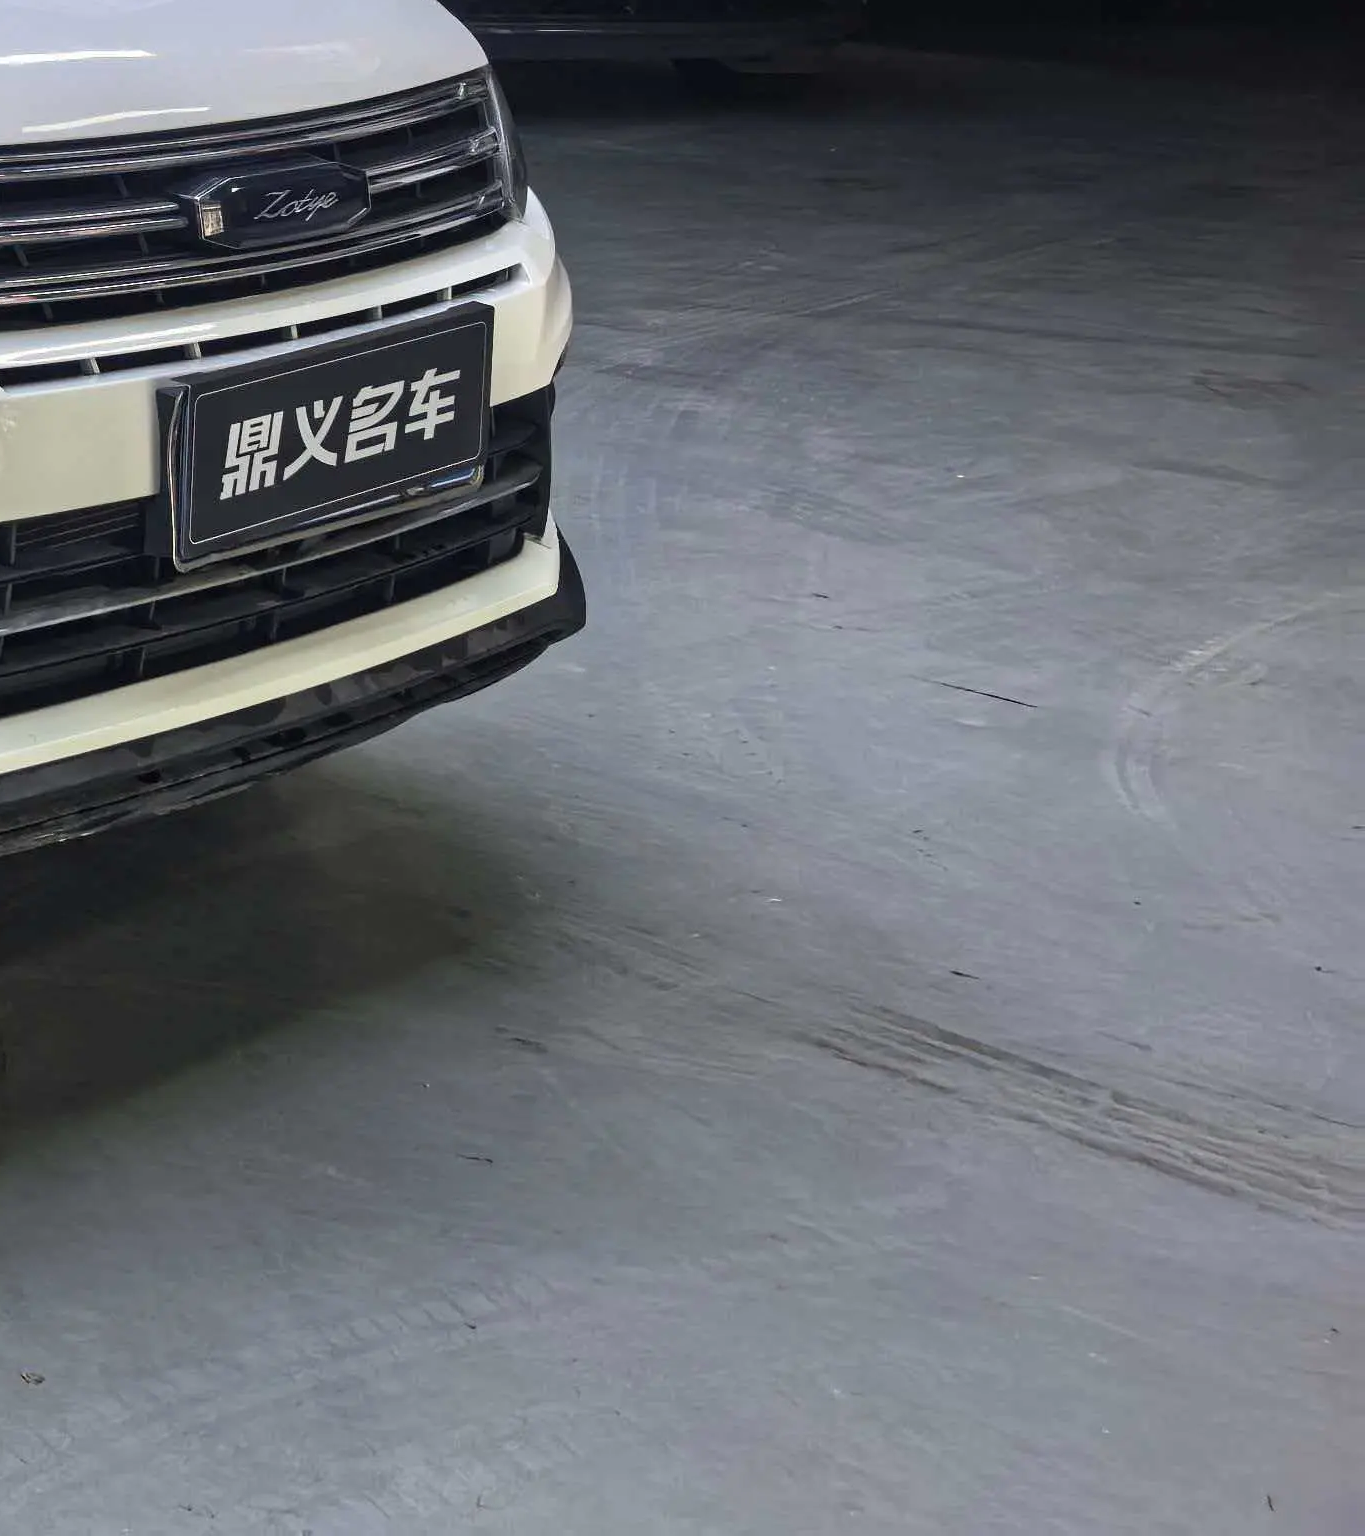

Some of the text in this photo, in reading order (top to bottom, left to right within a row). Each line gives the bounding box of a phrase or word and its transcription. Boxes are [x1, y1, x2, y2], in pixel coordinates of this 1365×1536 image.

[253, 189, 339, 222] Zotye
[220, 367, 461, 501] 鼎义名车
